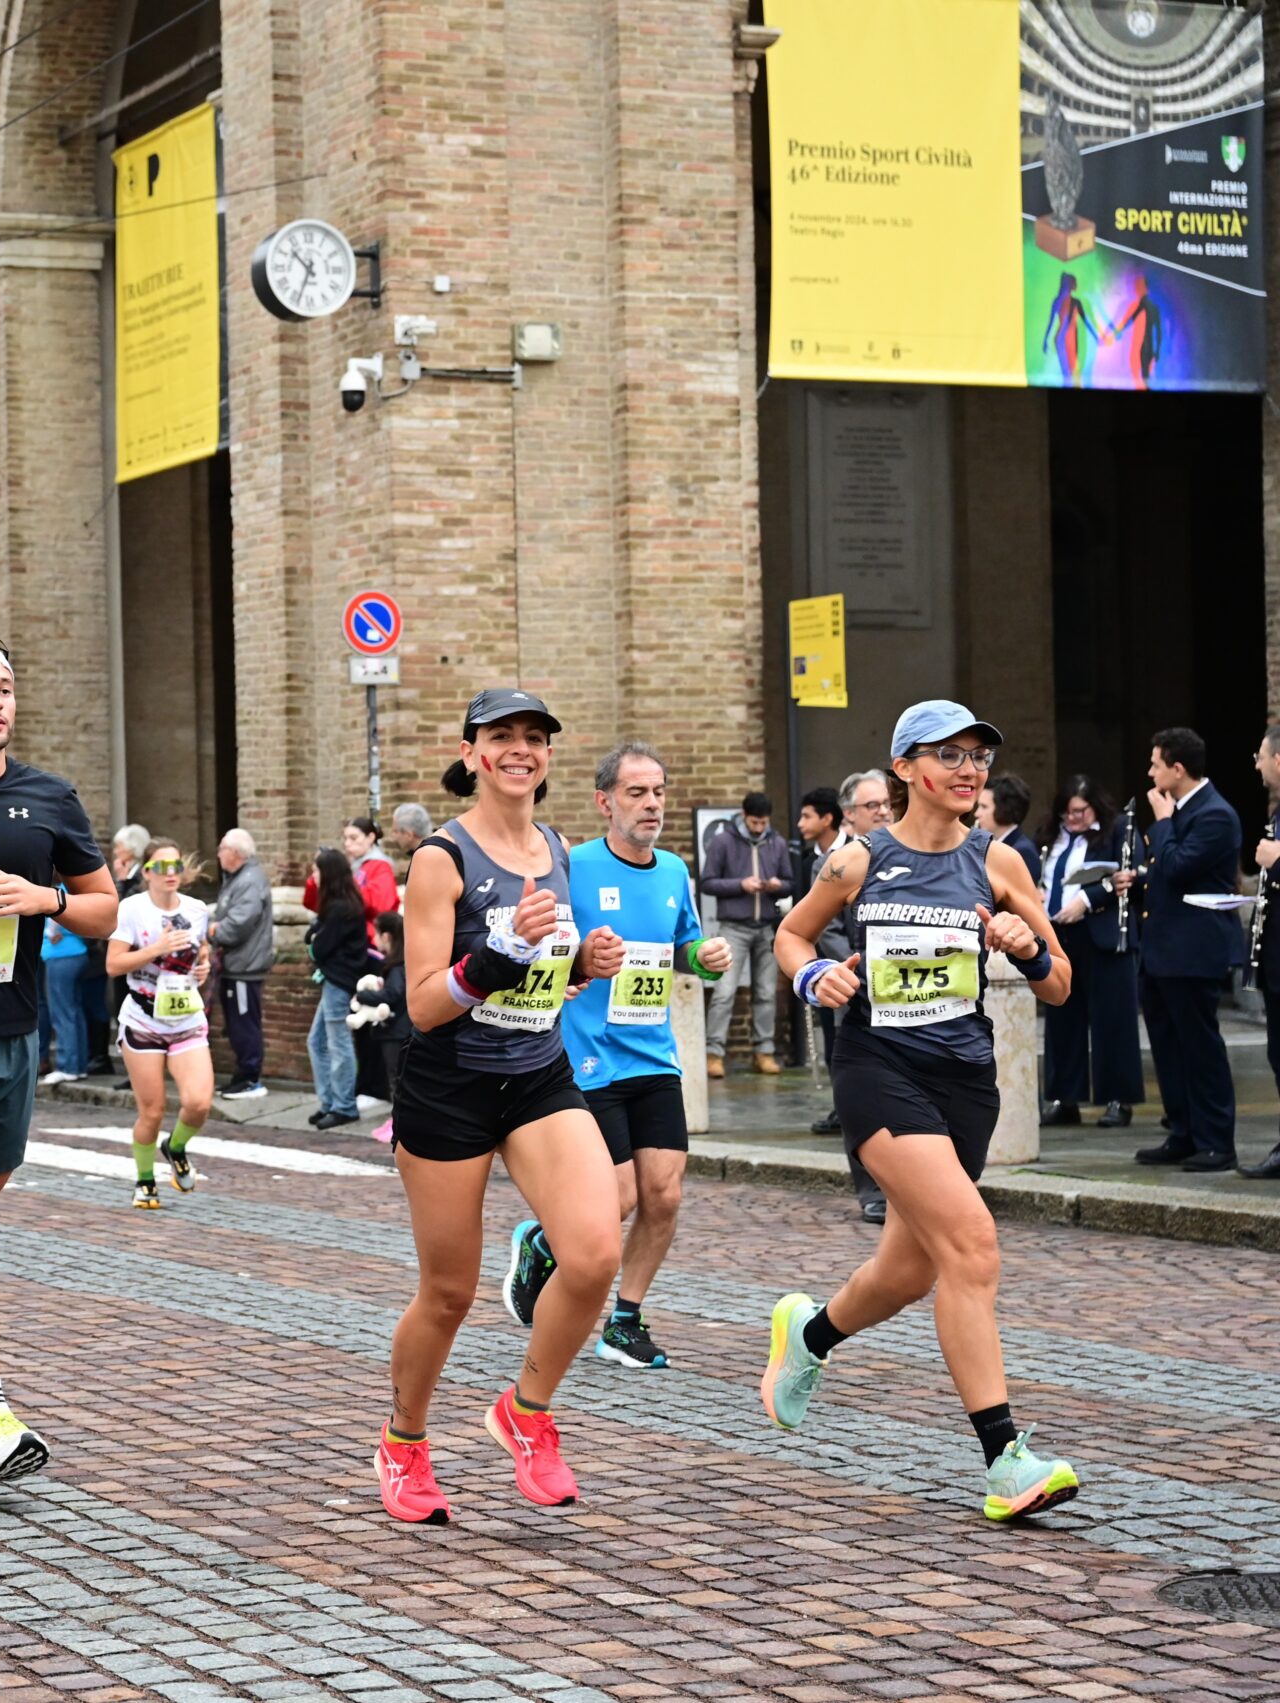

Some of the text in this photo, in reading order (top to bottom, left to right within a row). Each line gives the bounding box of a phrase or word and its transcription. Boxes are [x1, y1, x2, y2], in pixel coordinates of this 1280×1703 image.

[787, 138, 973, 168] Premio Sport Civiltà
[825, 165, 900, 187] Edizione
[1211, 179, 1248, 194] PREMIO
[1169, 191, 1248, 208] INTERNAZIONALE
[1115, 208, 1173, 233] SPORT
[1205, 242, 1248, 257] EDIZIONE
[857, 903, 981, 930] CORREREPERSEMPRE
[632, 977, 664, 996] 233
[899, 966, 949, 990] 175
[908, 991, 941, 1003] LAURA
[480, 1009, 497, 1019] YOU
[500, 1014, 538, 1025] DESERVE
[898, 1007, 937, 1018] DESERVE
[939, 1005, 946, 1013] IT
